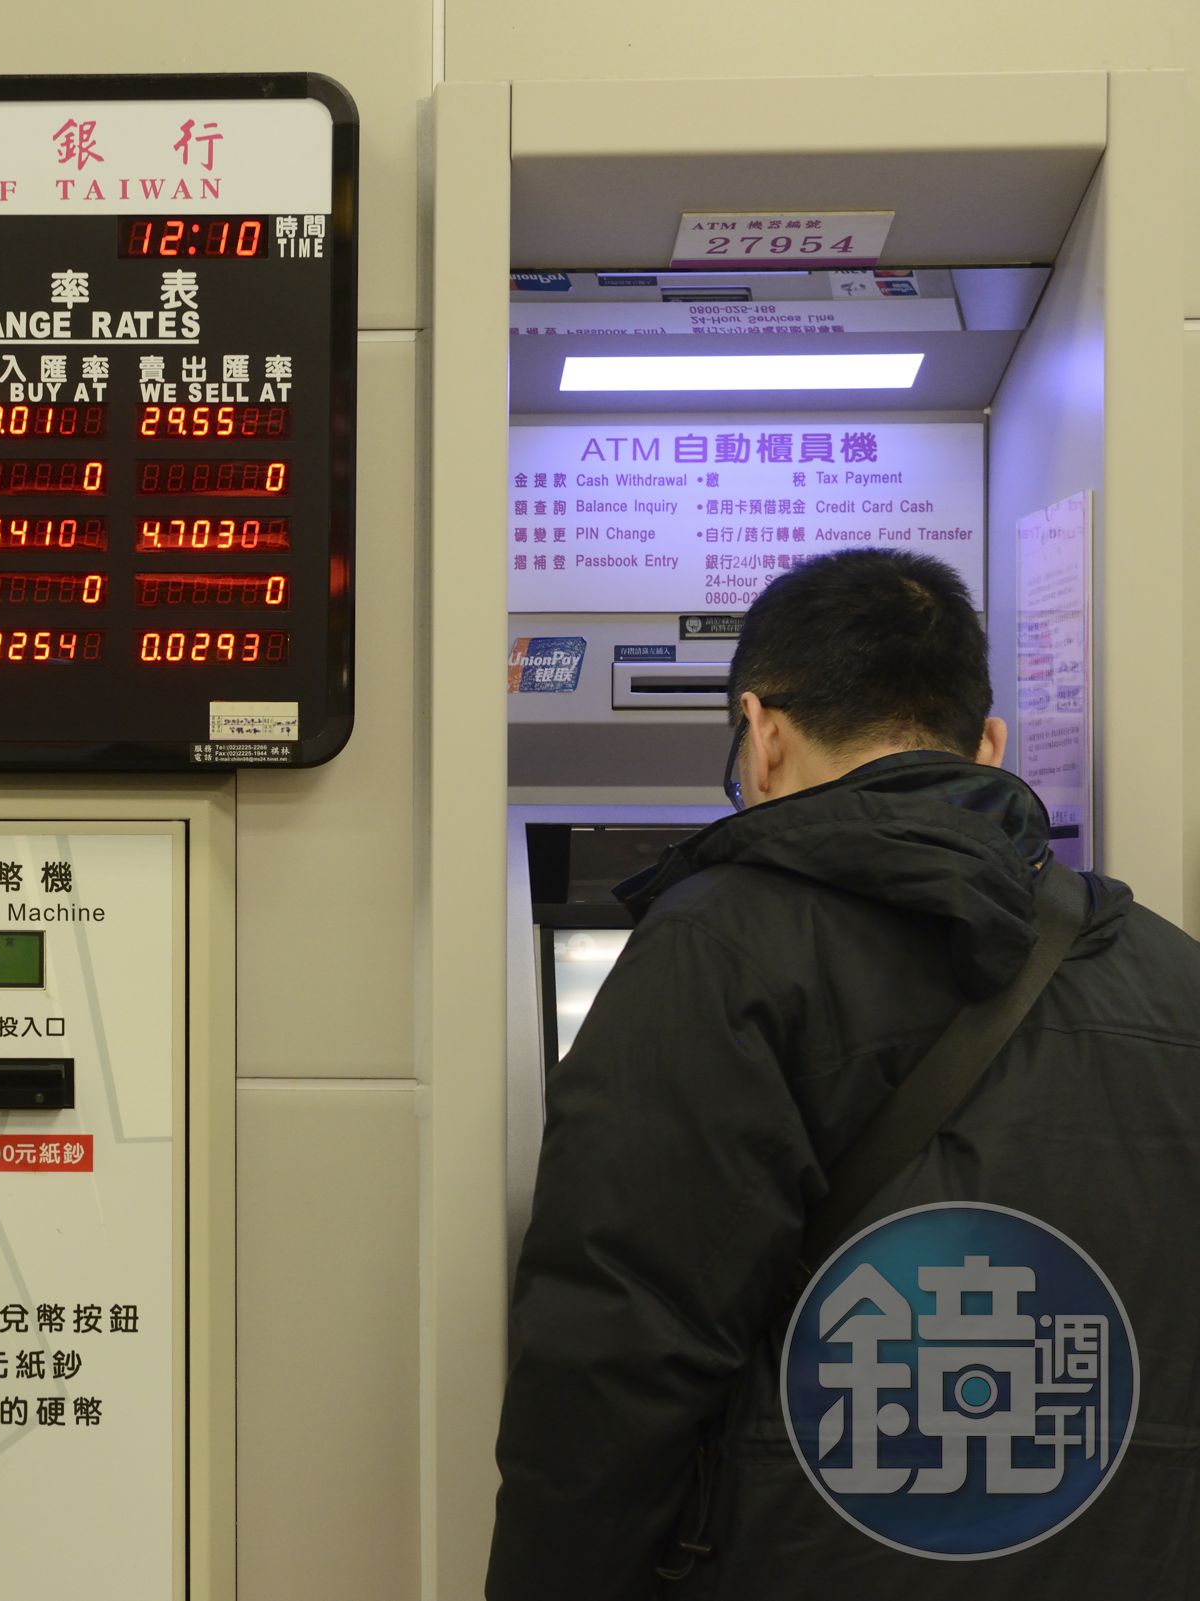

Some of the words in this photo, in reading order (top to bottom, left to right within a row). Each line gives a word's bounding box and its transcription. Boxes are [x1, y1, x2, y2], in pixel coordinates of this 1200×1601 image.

[55, 178, 222, 201] TAIWAN
[276, 215, 325, 238] 時間
[692, 222, 737, 230] ATM
[140, 220, 261, 257] 12:10
[278, 238, 324, 258] TIME
[705, 236, 854, 254] 27954
[92, 311, 200, 339] RATES
[139, 355, 292, 382] 賣出匯率
[10, 383, 61, 402] BUY
[73, 383, 107, 402] AT
[140, 383, 177, 402] WE
[188, 383, 249, 403] SELL
[260, 383, 292, 402] AT
[581, 437, 660, 462] ATM
[674, 432, 878, 464] 自動櫃員機
[83, 463, 102, 491] 0
[266, 463, 285, 491] 0
[514, 473, 566, 488] 金提款
[576, 474, 608, 486] Cash
[616, 473, 687, 486] Withdrawal
[816, 471, 838, 484] Tax
[845, 470, 903, 486] Payment
[514, 500, 566, 516] 額查詢
[576, 499, 627, 512] Balance
[634, 500, 678, 515] Inquiry
[706, 499, 806, 515] 信用卡預借現金
[816, 500, 855, 513] Credit
[862, 499, 893, 513] Card
[900, 500, 933, 513] Cash
[514, 527, 566, 543] 碼變更
[576, 527, 599, 540] PIN
[606, 527, 656, 542] Change
[815, 527, 871, 541] Advance
[878, 527, 911, 541] Fund
[918, 527, 973, 541] Transfer
[575, 554, 638, 567] Passbook
[645, 554, 679, 569] Entry
[83, 576, 101, 604] 0
[266, 577, 285, 604] 0
[705, 575, 757, 587] 24-Hour
[141, 633, 260, 661] 0.0293
[508, 651, 580, 668] UnionPay
[8, 902, 106, 921] Machine
